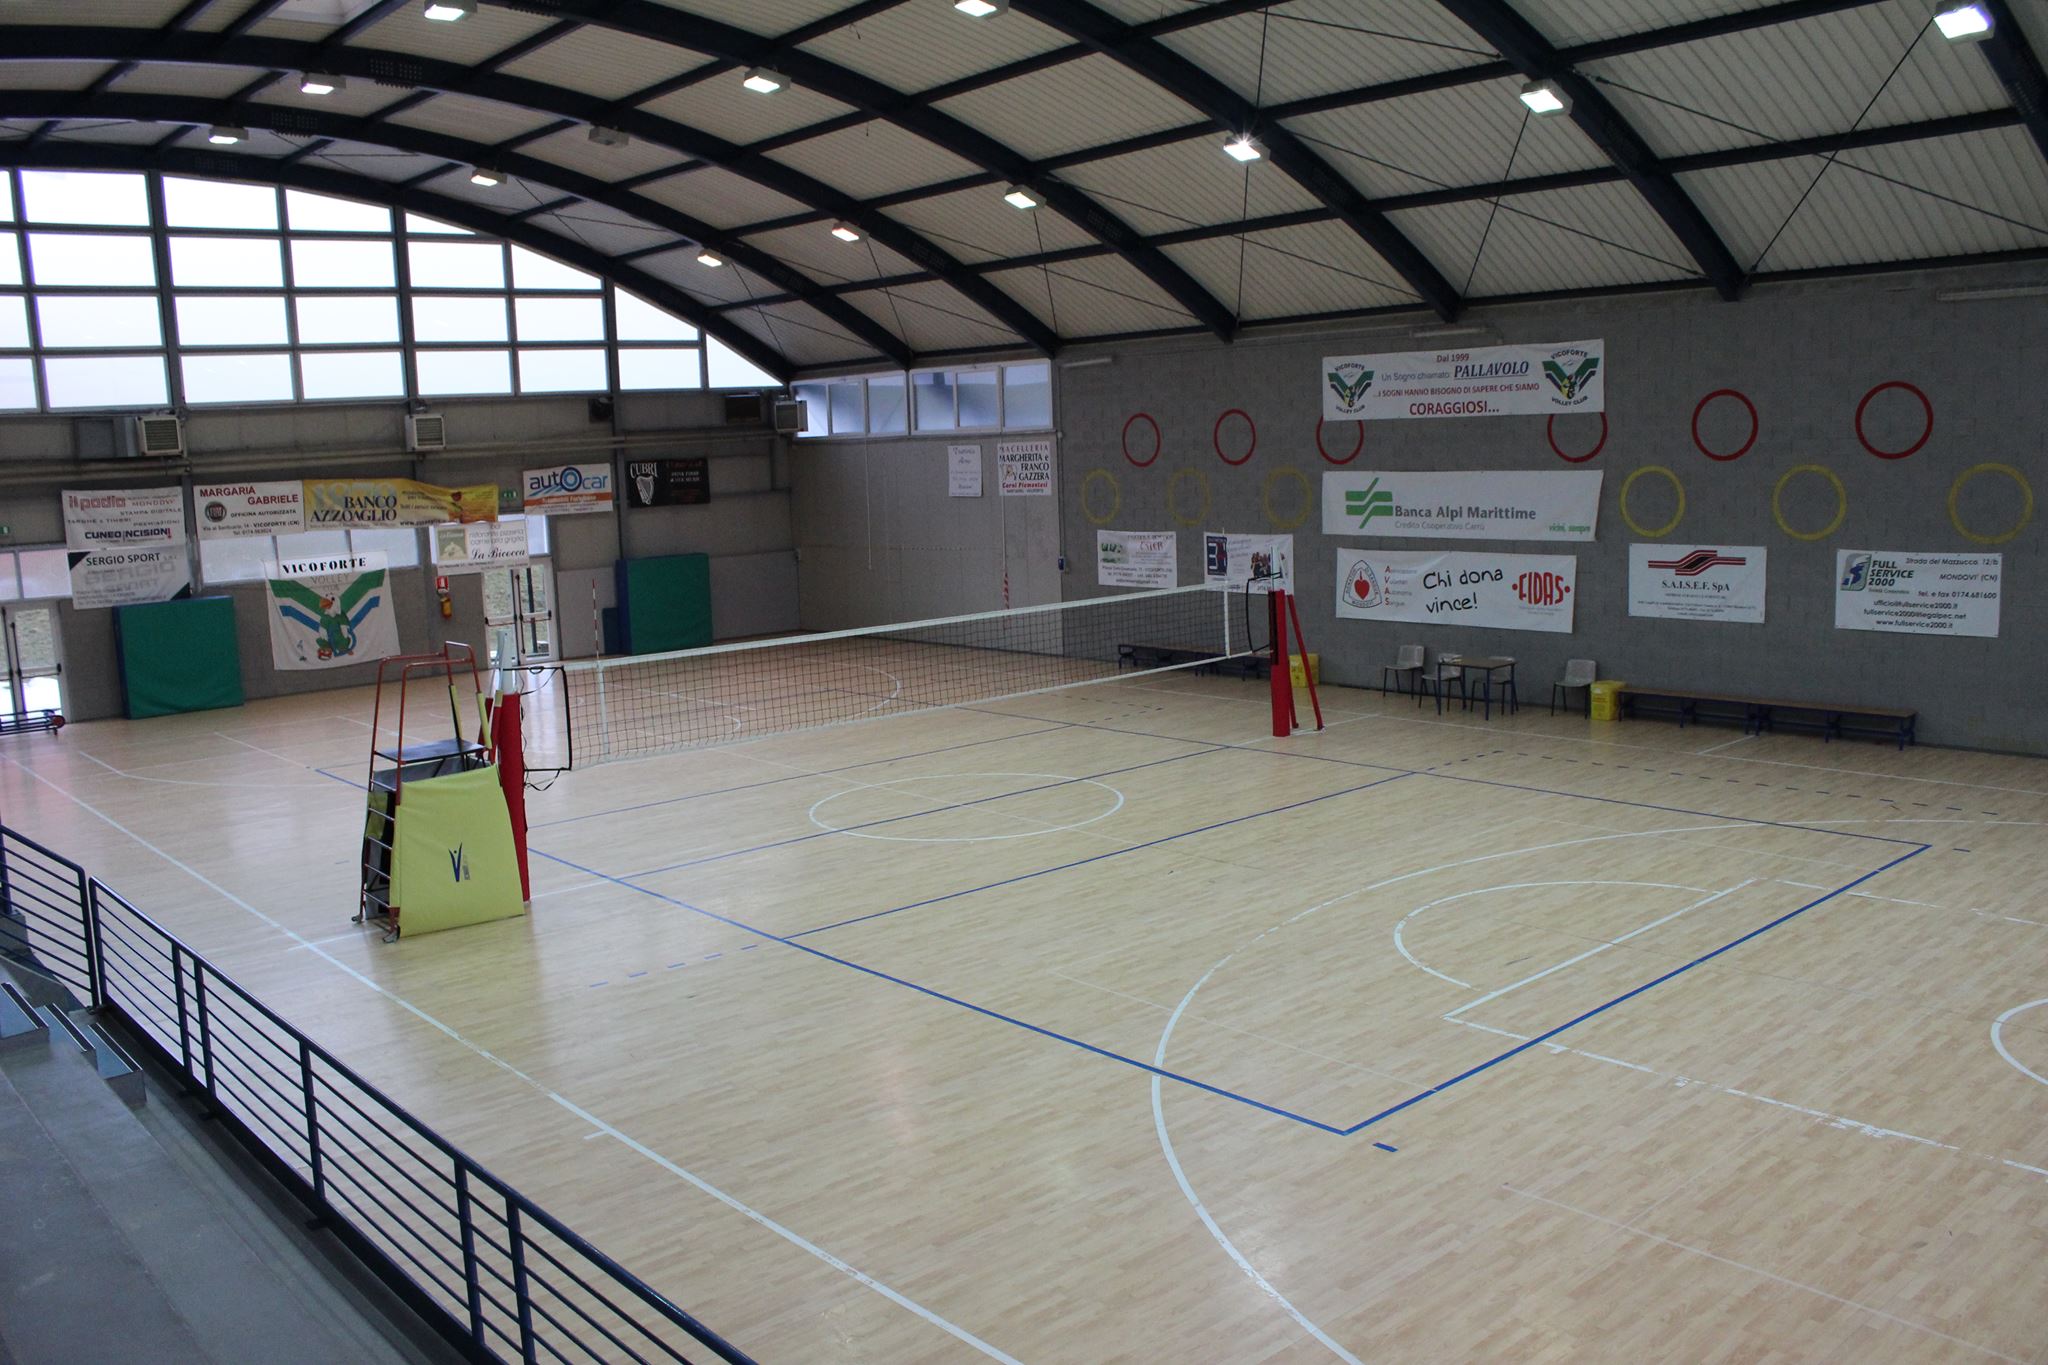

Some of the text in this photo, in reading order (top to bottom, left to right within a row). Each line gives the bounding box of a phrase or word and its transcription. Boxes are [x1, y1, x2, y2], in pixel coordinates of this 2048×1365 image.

[1437, 353, 1470, 363] Dal 1999
[1382, 360, 1530, 383] Un Sogno chiamato PALLAVOLO
[1382, 389, 1404, 397] SOGNI
[1404, 388, 1429, 396] HANNO
[1430, 388, 1462, 396] BISOGNO
[1472, 385, 1498, 393] SAPERE
[1500, 384, 1515, 392] CHE
[1515, 382, 1541, 391] SIAMO
[999, 453, 1042, 462] MARGHERITA
[630, 462, 658, 478] CUBRI
[1020, 462, 1050, 472] FRANCO
[1018, 472, 1050, 481] GAZZERA
[200, 486, 256, 498] MARGARIA
[248, 494, 299, 505] GABRIELE
[344, 496, 398, 508] BANCO
[310, 510, 398, 522] AZZOAGLIO
[1395, 505, 1536, 521] Banca Alpi Marittime
[1395, 521, 1420, 529] Credito
[85, 531, 122, 540] CUNEO
[488, 548, 526, 559] Bicocca
[86, 556, 124, 566] SERGIO
[128, 553, 160, 564] SPORT
[1872, 560, 1898, 570] FULL
[282, 557, 367, 574] VICOFORTE
[310, 573, 350, 584] VOLLEY
[1423, 568, 1504, 589] Chi dona
[1870, 569, 1915, 579] SERVICE
[1980, 574, 1998, 582] (CN)
[1662, 580, 1730, 593] S.A.I.S.E.F. SpA
[1868, 578, 1895, 587] 2000
[1518, 572, 1564, 606] FIDAS
[1426, 592, 1478, 614] vince!
